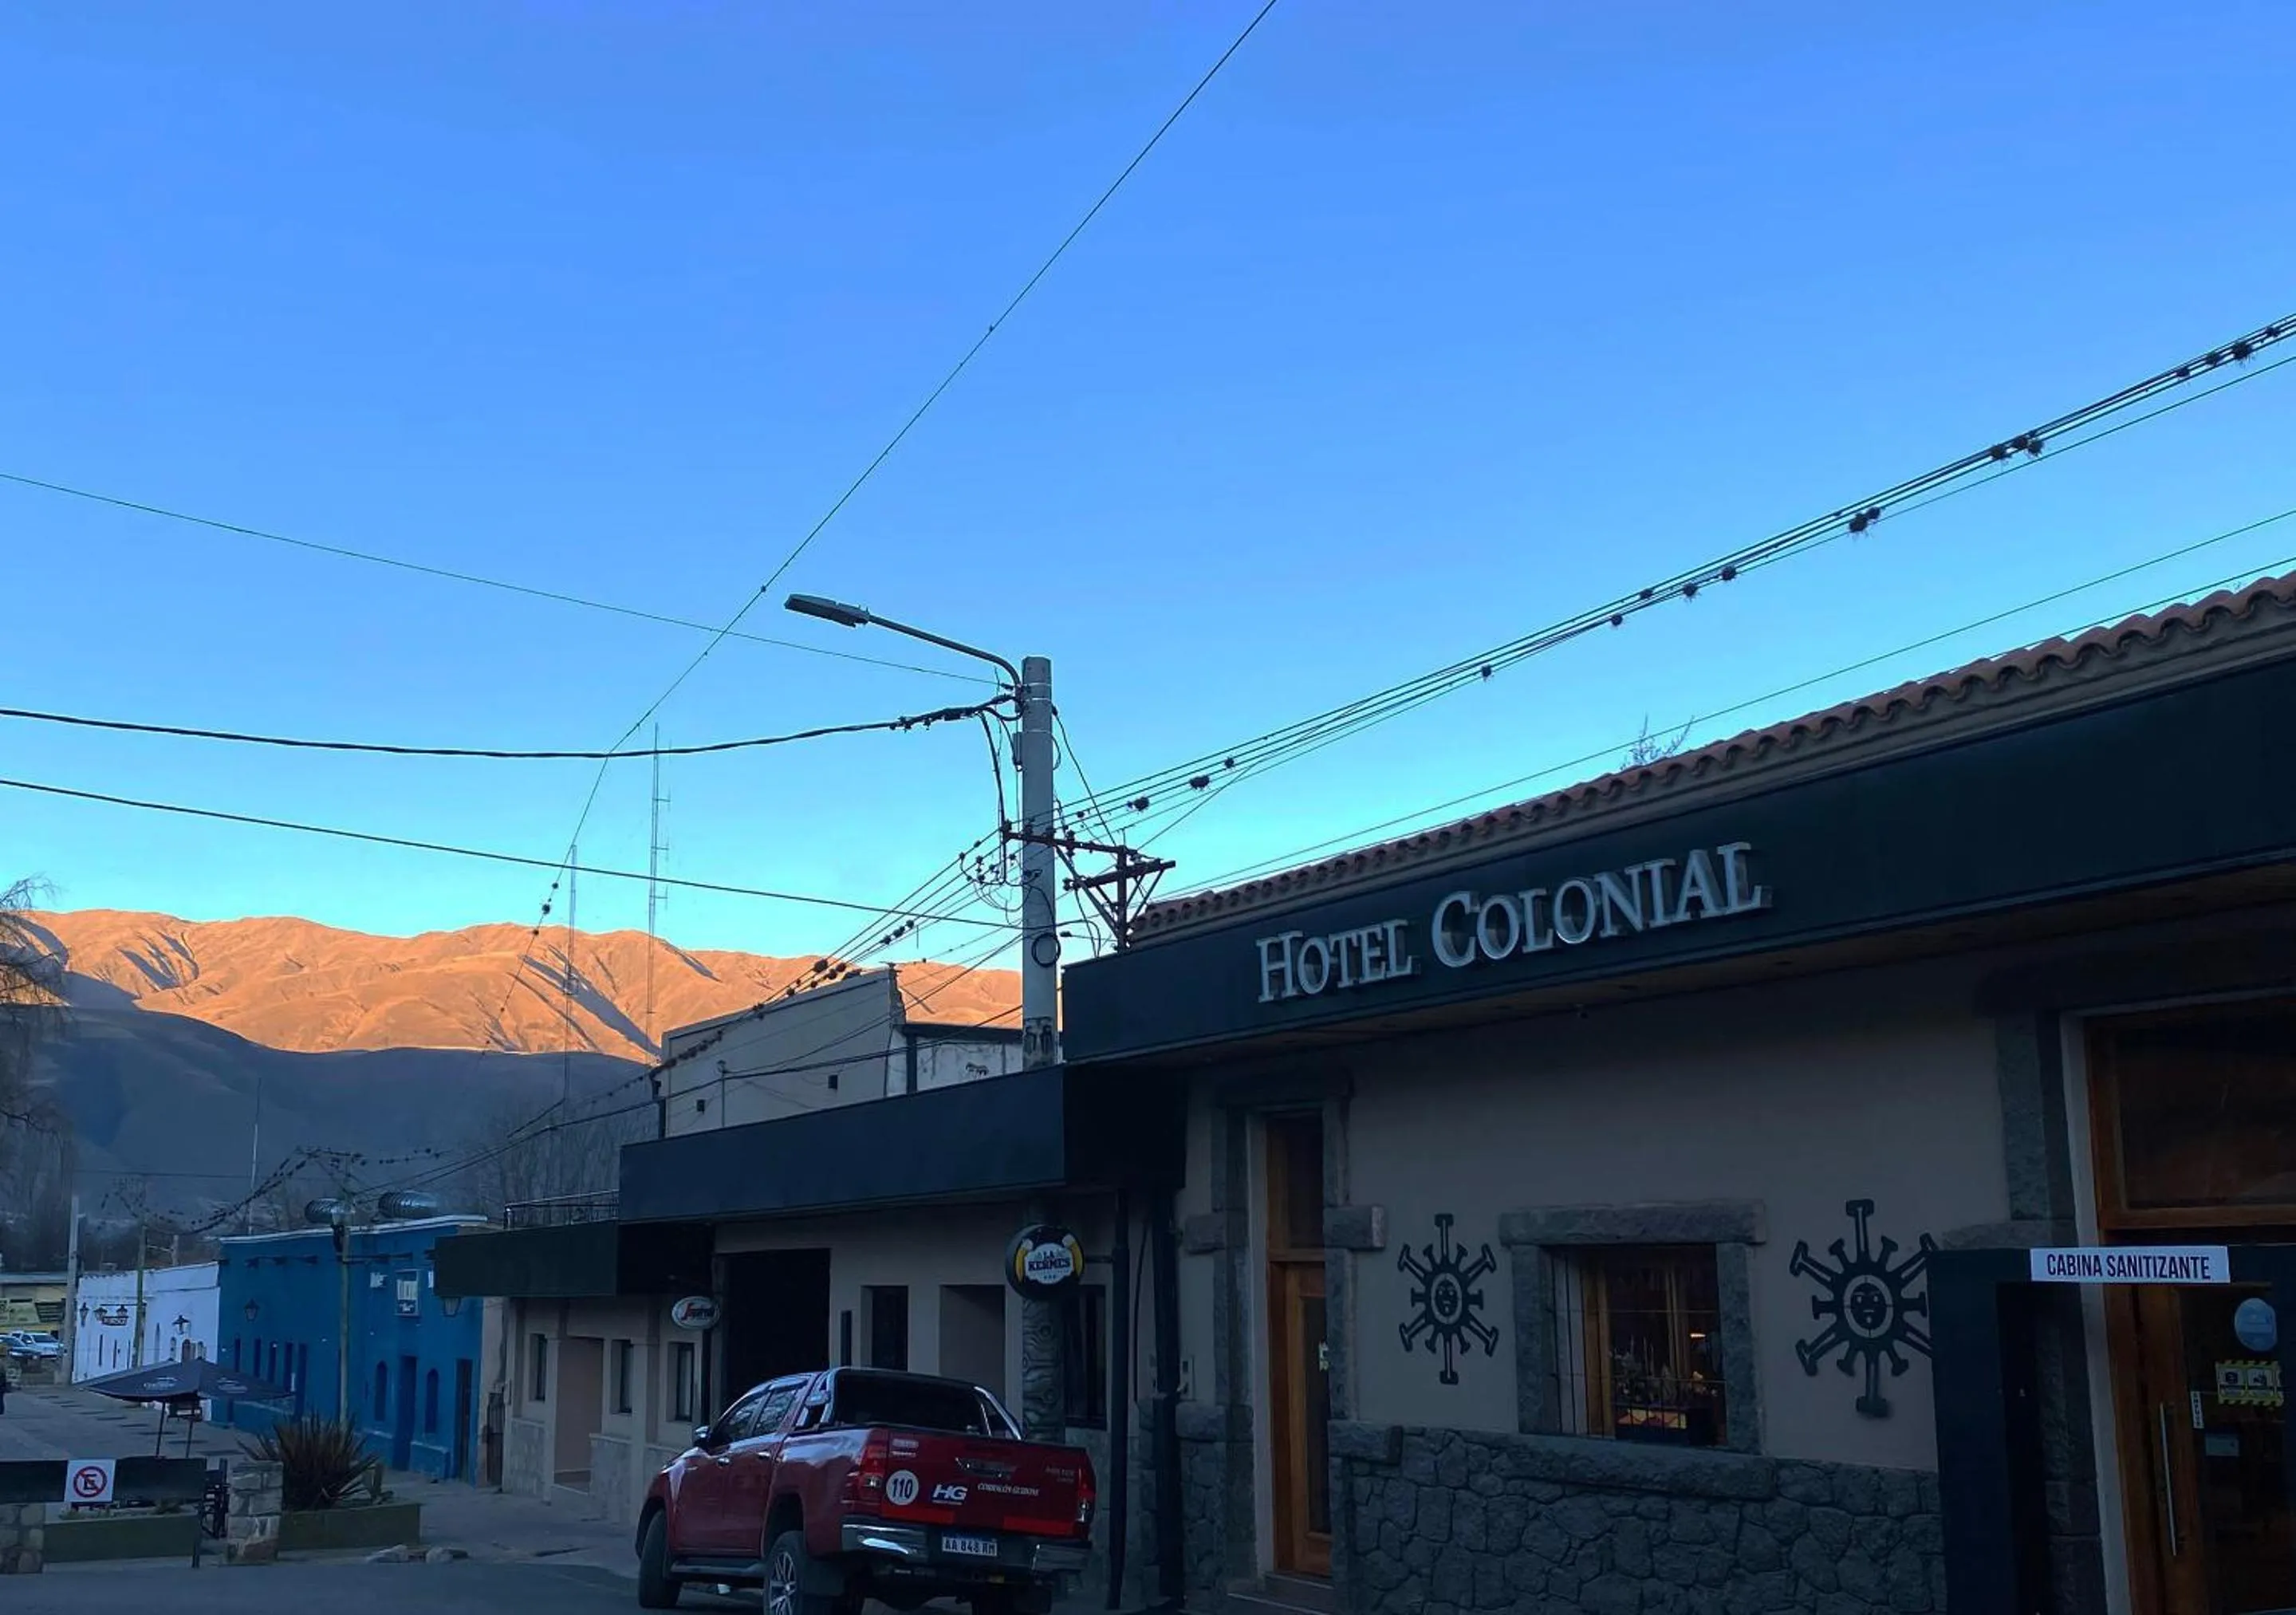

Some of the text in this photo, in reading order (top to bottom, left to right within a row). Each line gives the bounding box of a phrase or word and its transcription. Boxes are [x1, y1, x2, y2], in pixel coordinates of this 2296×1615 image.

[1043, 1250, 1055, 1259] LA
[2047, 1253, 2211, 1279] CABINA SANITIZANTE
[892, 1478, 913, 1499] 110
[932, 1483, 968, 1500] HG
